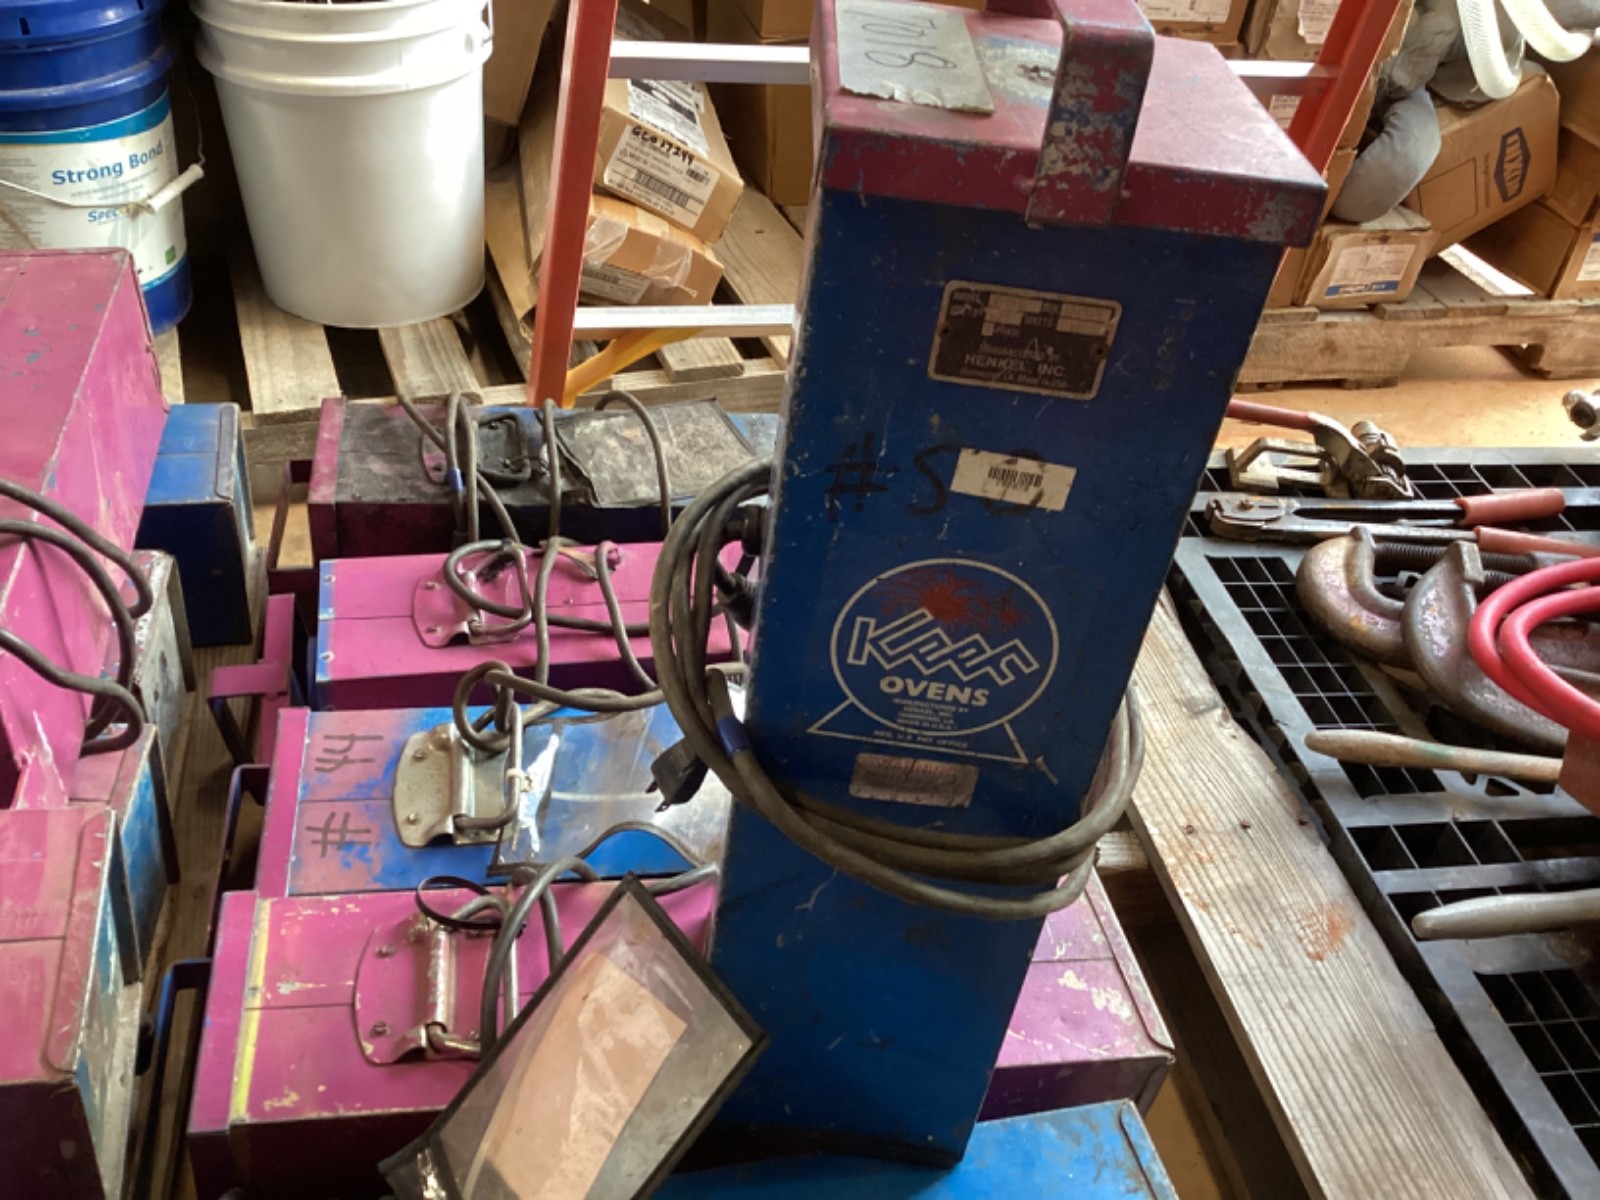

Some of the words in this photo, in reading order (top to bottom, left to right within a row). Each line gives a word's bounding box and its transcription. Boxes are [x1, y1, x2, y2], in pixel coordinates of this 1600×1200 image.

[51, 161, 124, 186] Strong
[129, 139, 163, 169] Bond
[879, 675, 989, 707] OVENS
